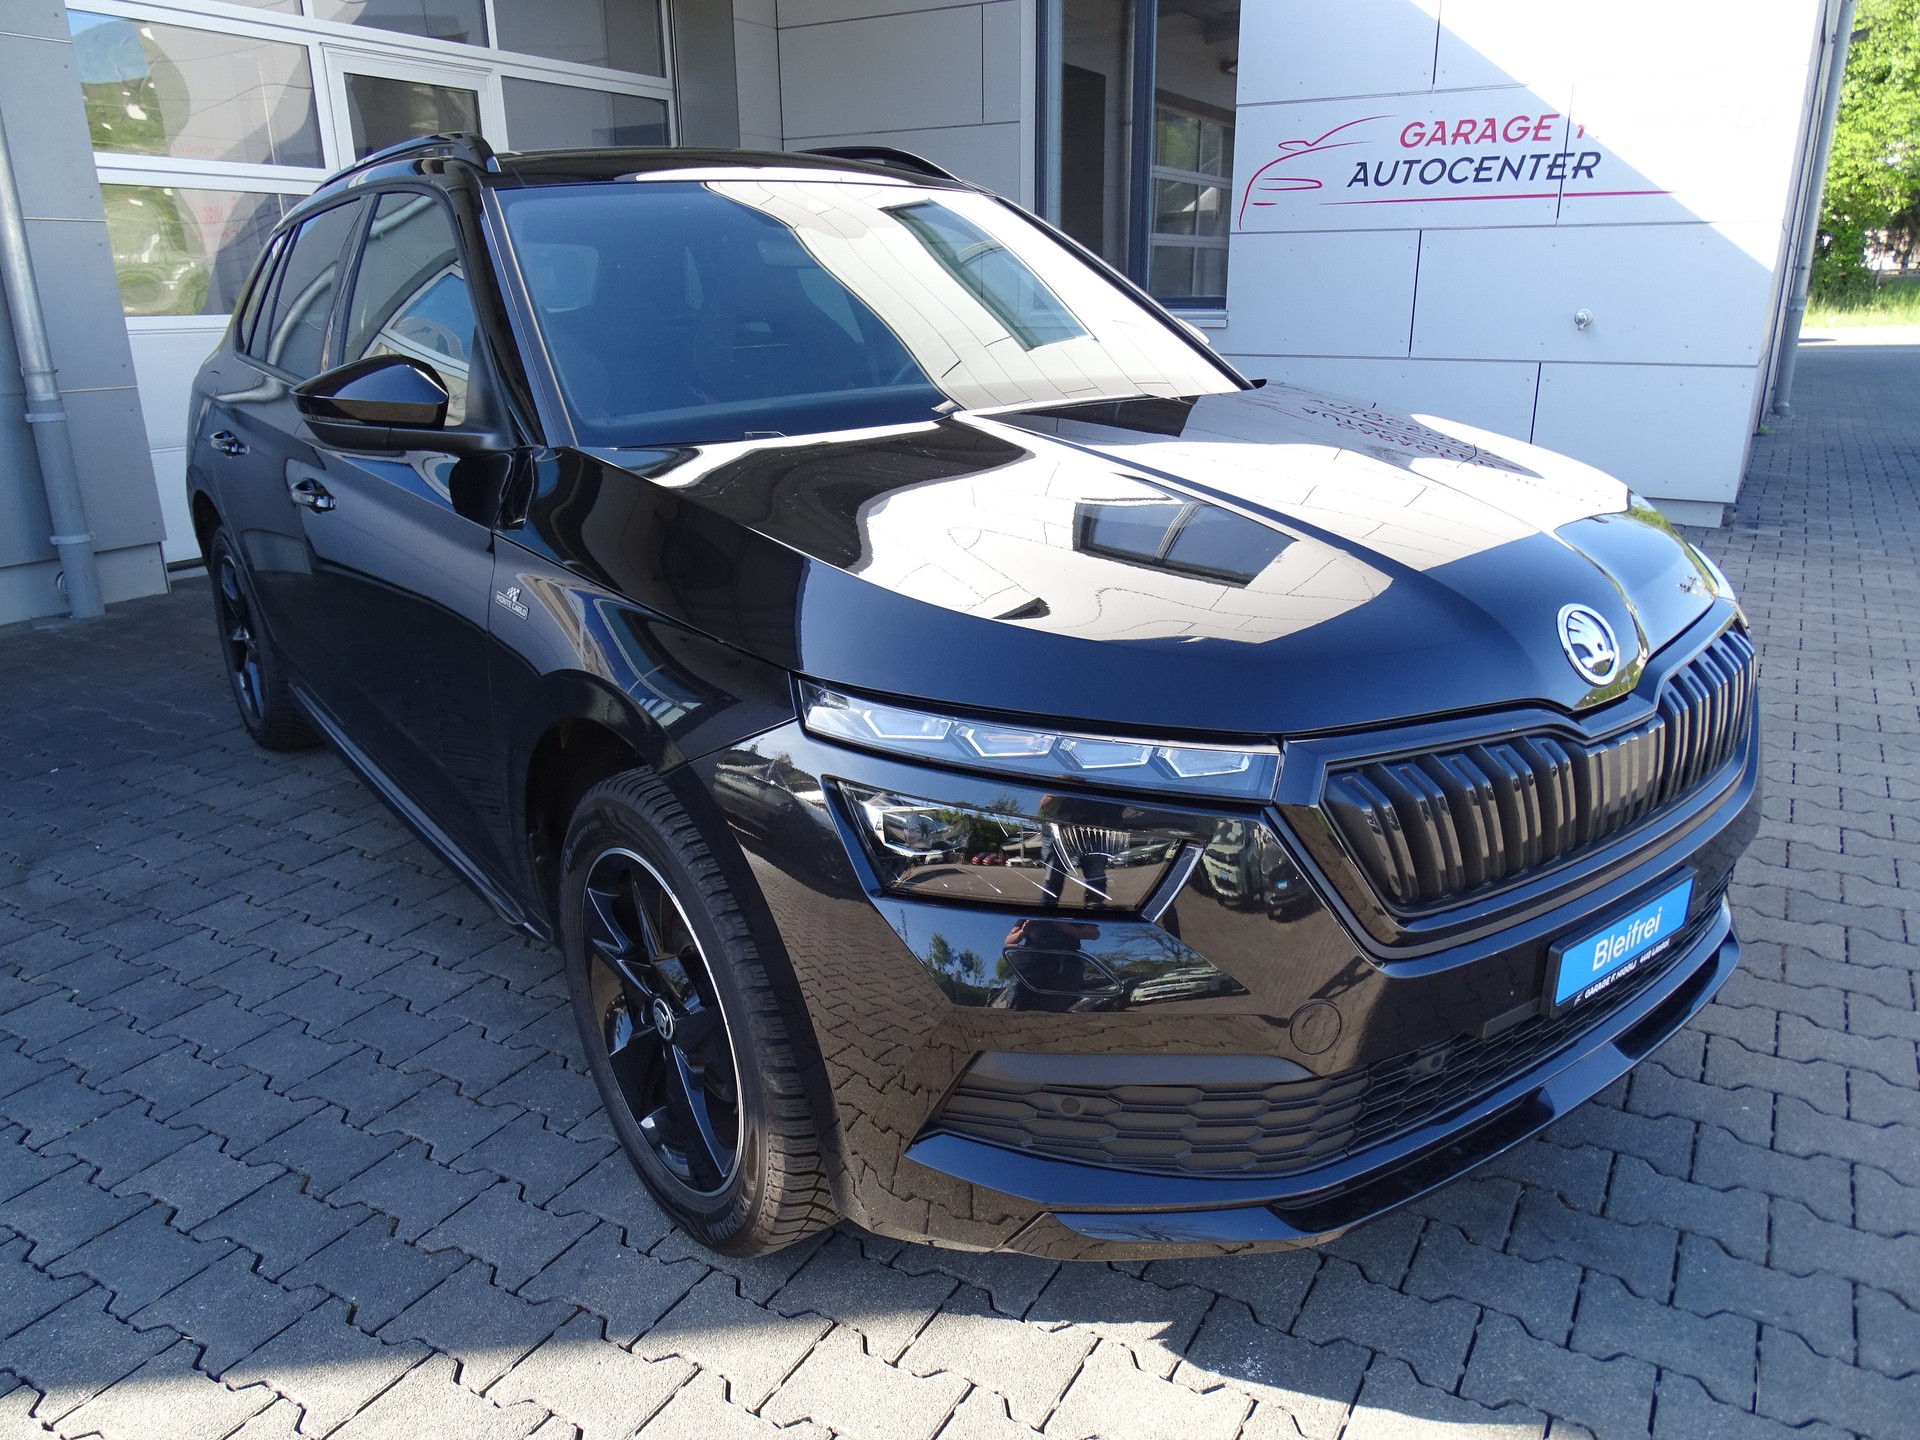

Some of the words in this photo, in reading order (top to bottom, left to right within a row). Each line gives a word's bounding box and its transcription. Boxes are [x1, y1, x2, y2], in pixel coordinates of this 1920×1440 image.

[1400, 113, 1560, 149] GARAGE
[1347, 151, 1601, 188] AUTOCENTER
[497, 594, 512, 608] MONTE
[512, 602, 527, 617] CARLO
[1592, 906, 1663, 972] Bleifrei
[1584, 977, 1611, 999] GARAGE
